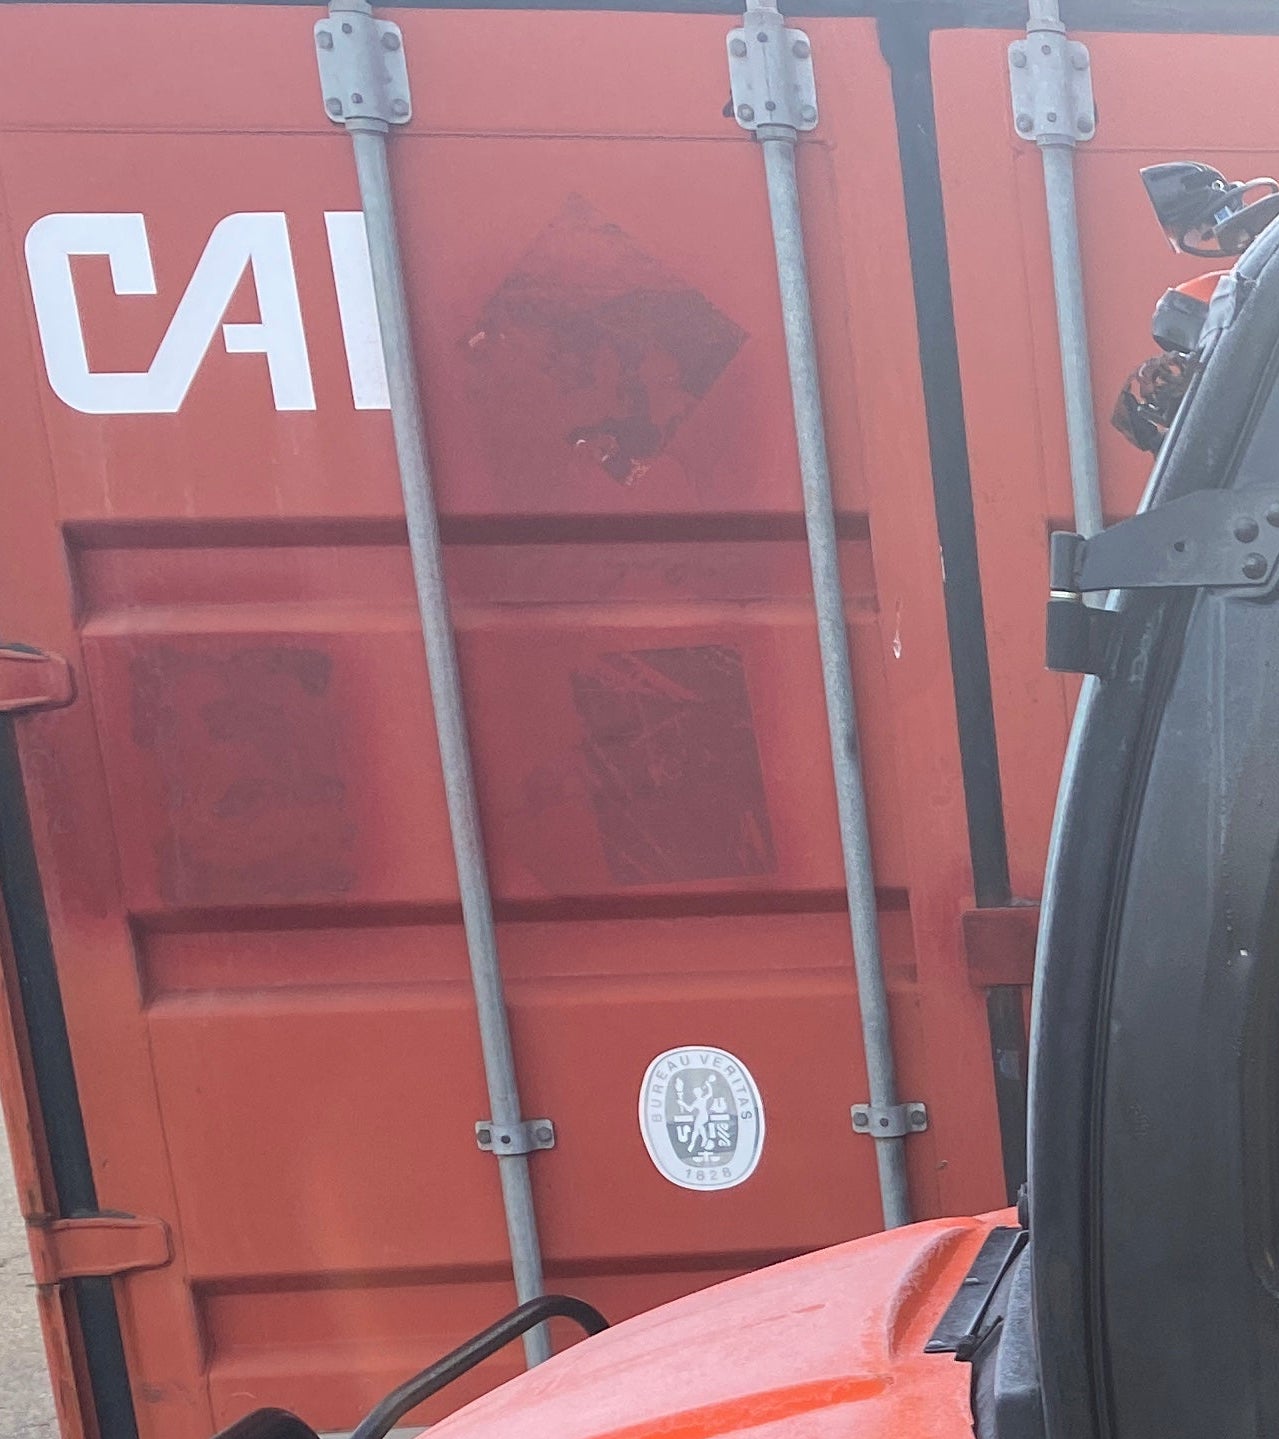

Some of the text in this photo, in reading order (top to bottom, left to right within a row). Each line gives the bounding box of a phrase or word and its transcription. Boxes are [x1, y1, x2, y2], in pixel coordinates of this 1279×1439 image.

[24, 211, 391, 414] CAI
[651, 1054, 753, 1123] BUREAU VERITAS
[685, 1167, 732, 1181] 1828
